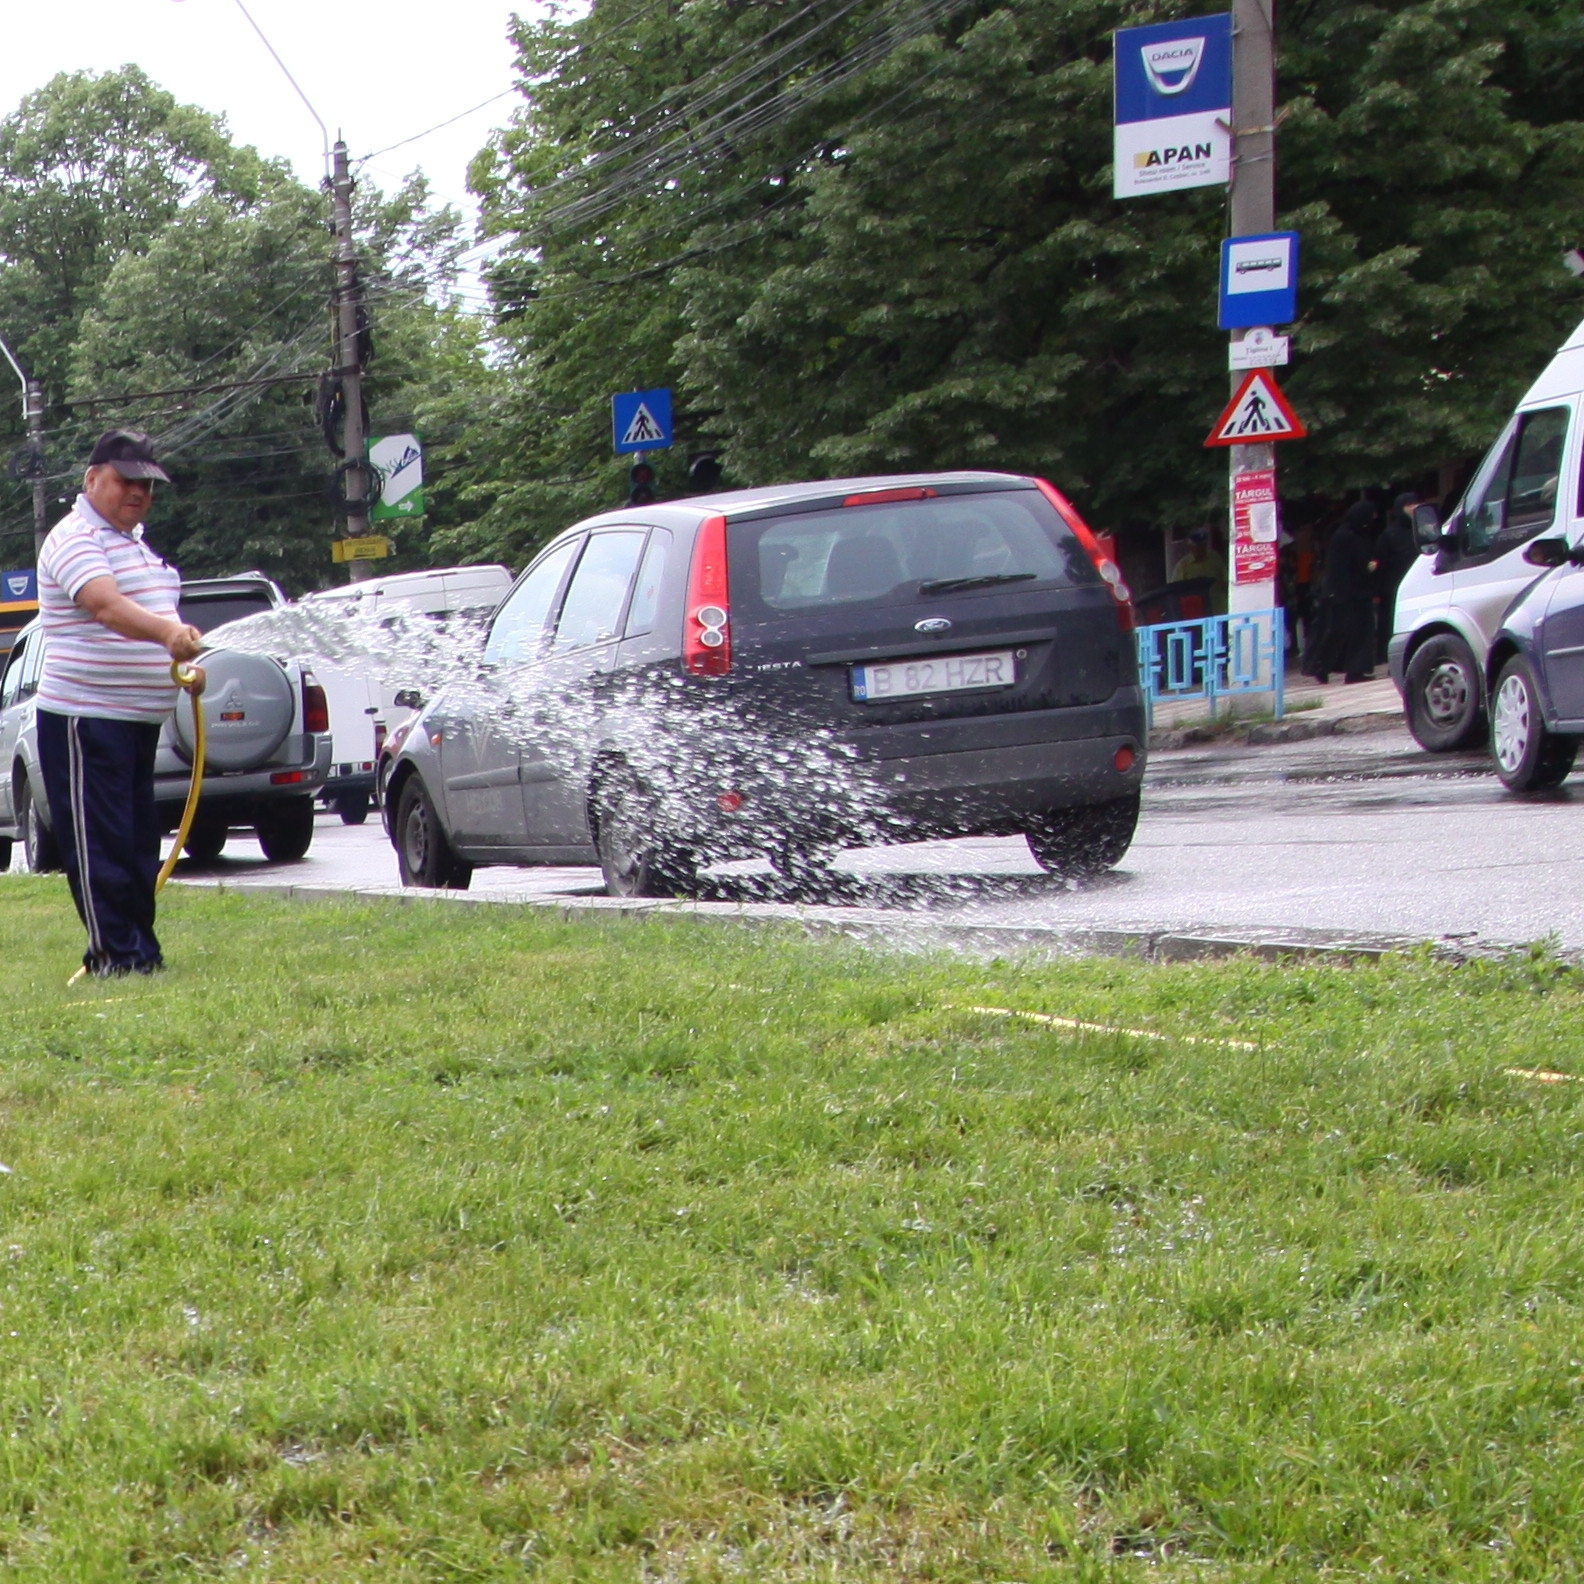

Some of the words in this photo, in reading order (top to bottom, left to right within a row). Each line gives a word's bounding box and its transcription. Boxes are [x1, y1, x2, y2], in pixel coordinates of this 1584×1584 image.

[1151, 48, 1193, 62] DACIA
[1144, 142, 1212, 168] APAN
[756, 660, 802, 672] IESTA
[873, 669, 891, 694] B
[905, 664, 936, 692] 82
[945, 657, 1004, 687] HZR
